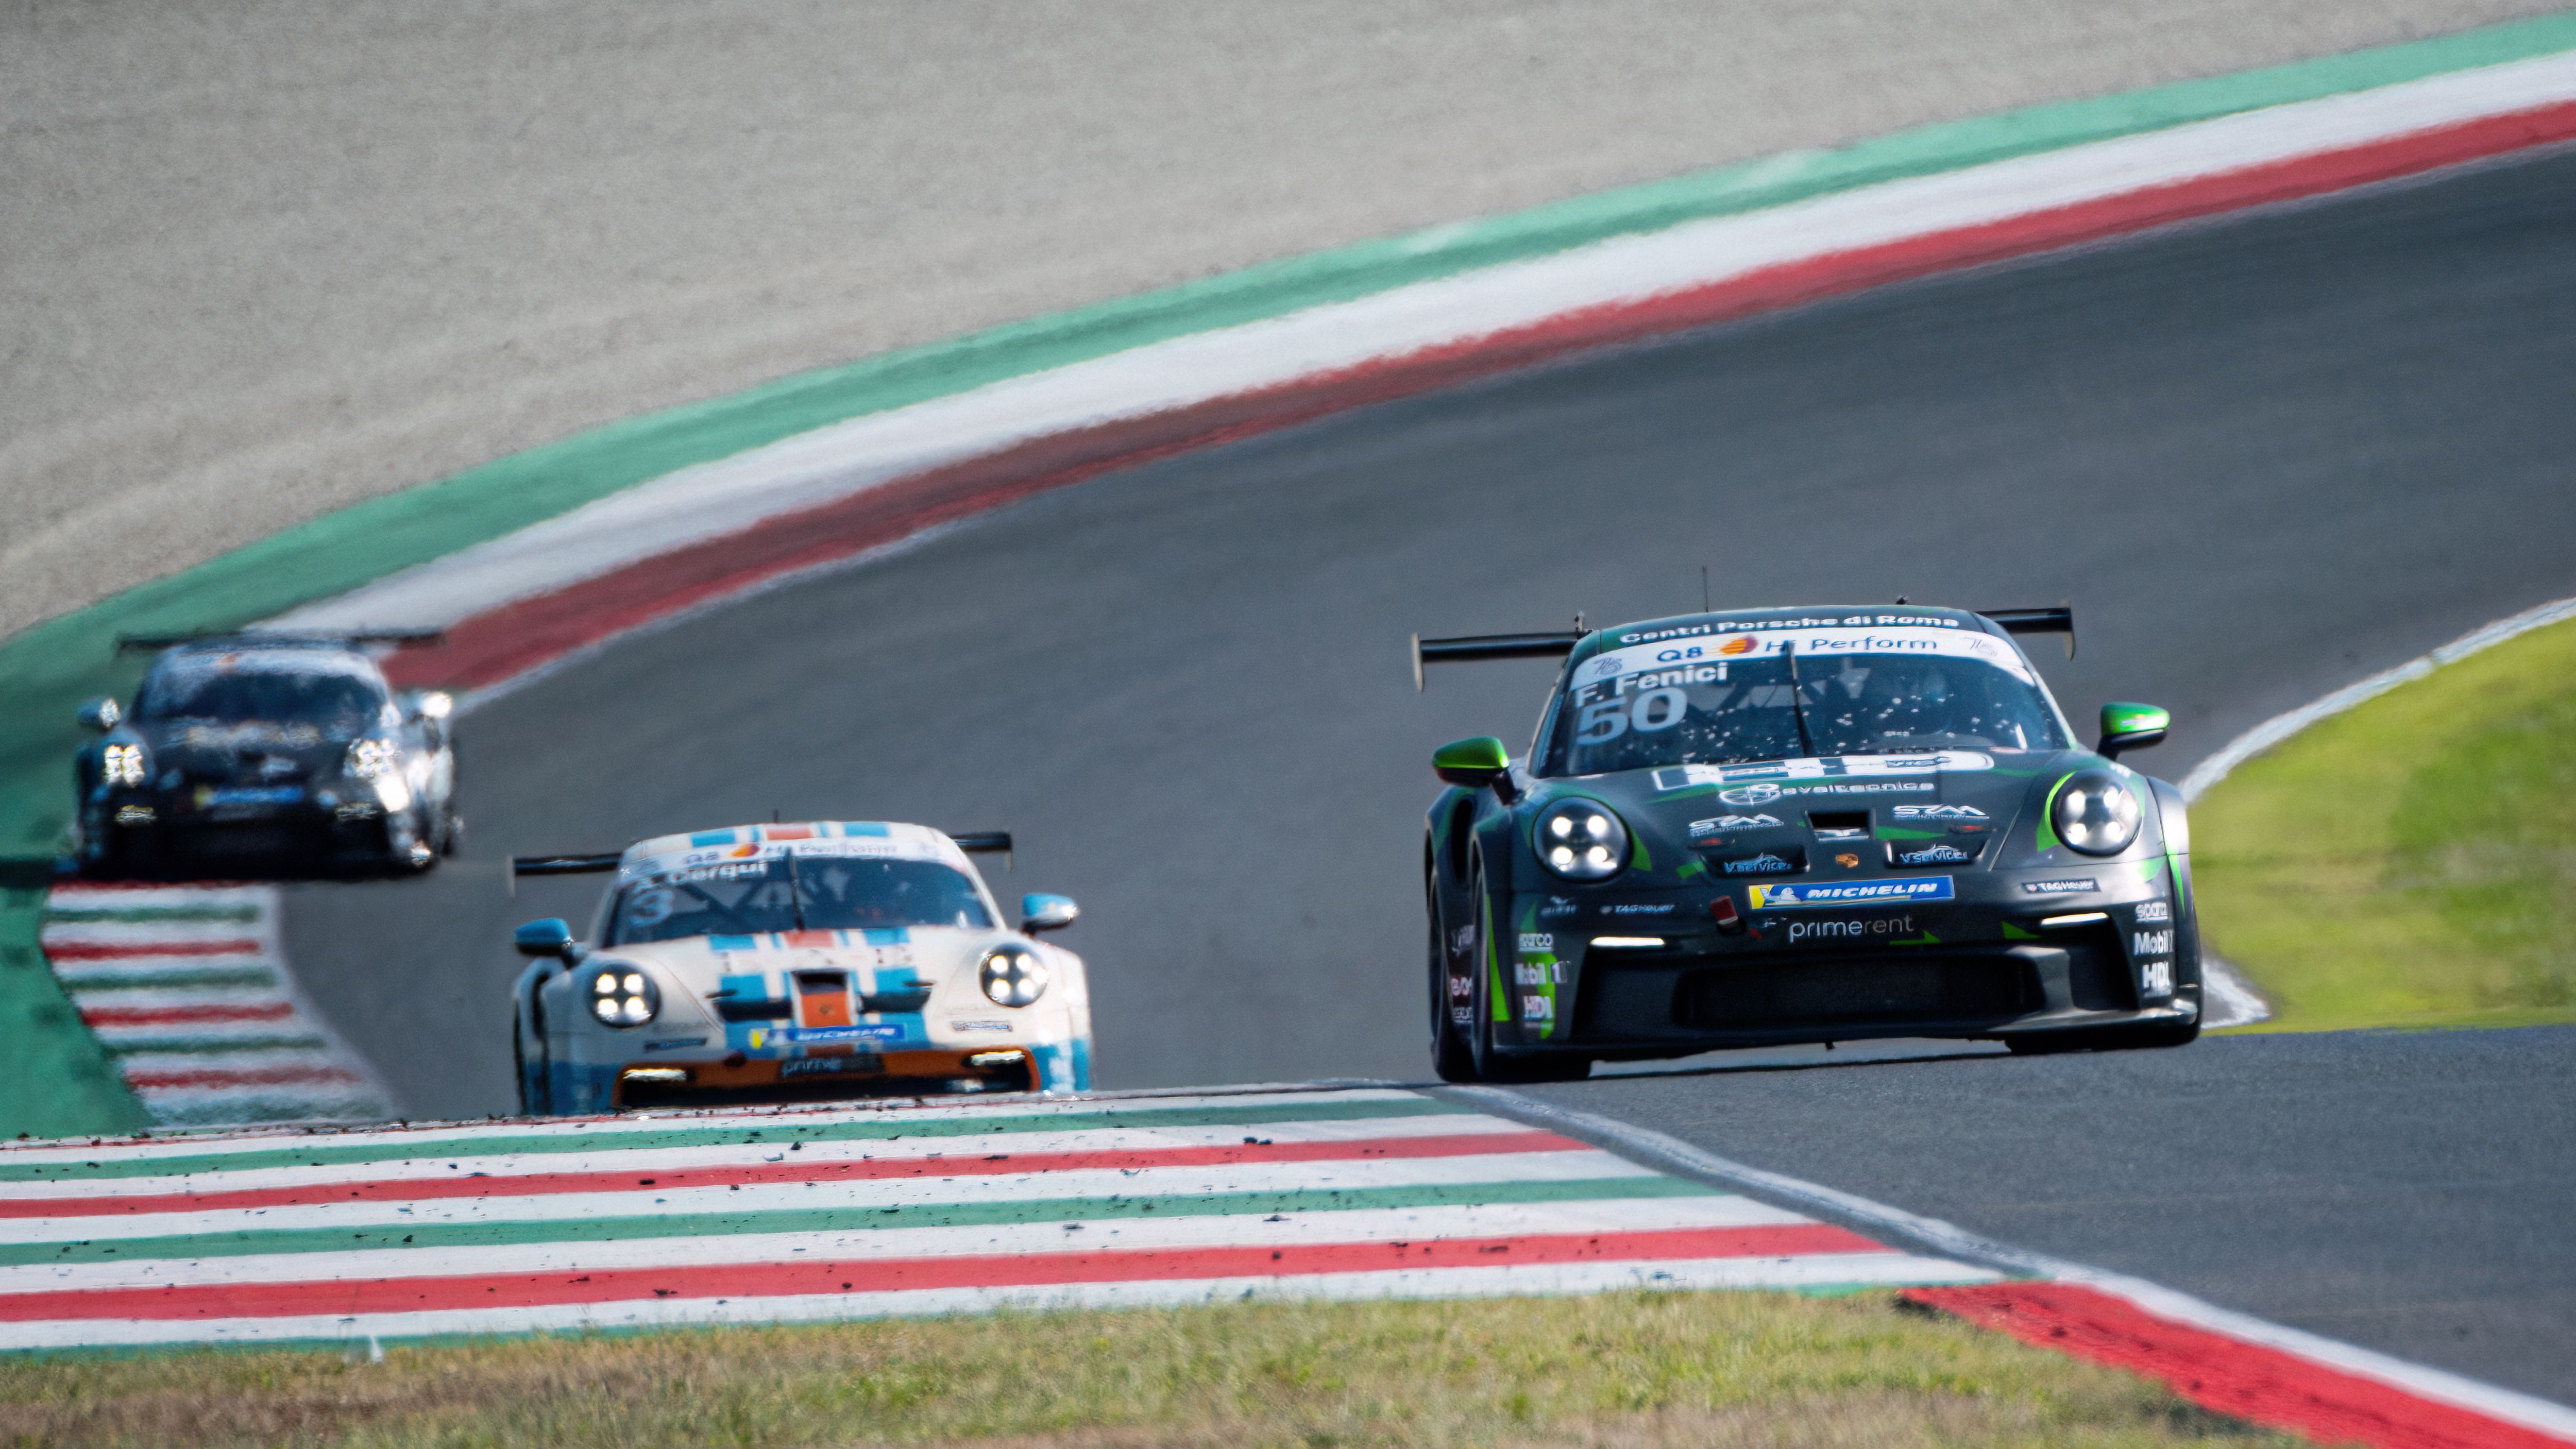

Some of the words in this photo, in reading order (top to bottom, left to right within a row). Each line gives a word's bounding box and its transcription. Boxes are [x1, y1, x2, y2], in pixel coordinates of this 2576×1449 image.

[1620, 624, 1710, 643] Centri
[1718, 618, 1838, 632] Porsche
[1843, 616, 1872, 626] di
[1876, 615, 1959, 627] Roma
[1657, 646, 1702, 662] Q8
[1811, 635, 1938, 651] Perform
[1575, 683, 1604, 708] F.
[1615, 661, 1729, 696] Fenici
[1576, 687, 1688, 745] 50
[1806, 883, 1938, 899] MICHELIN
[629, 889, 674, 927] 3
[1789, 914, 1914, 943] primerent
